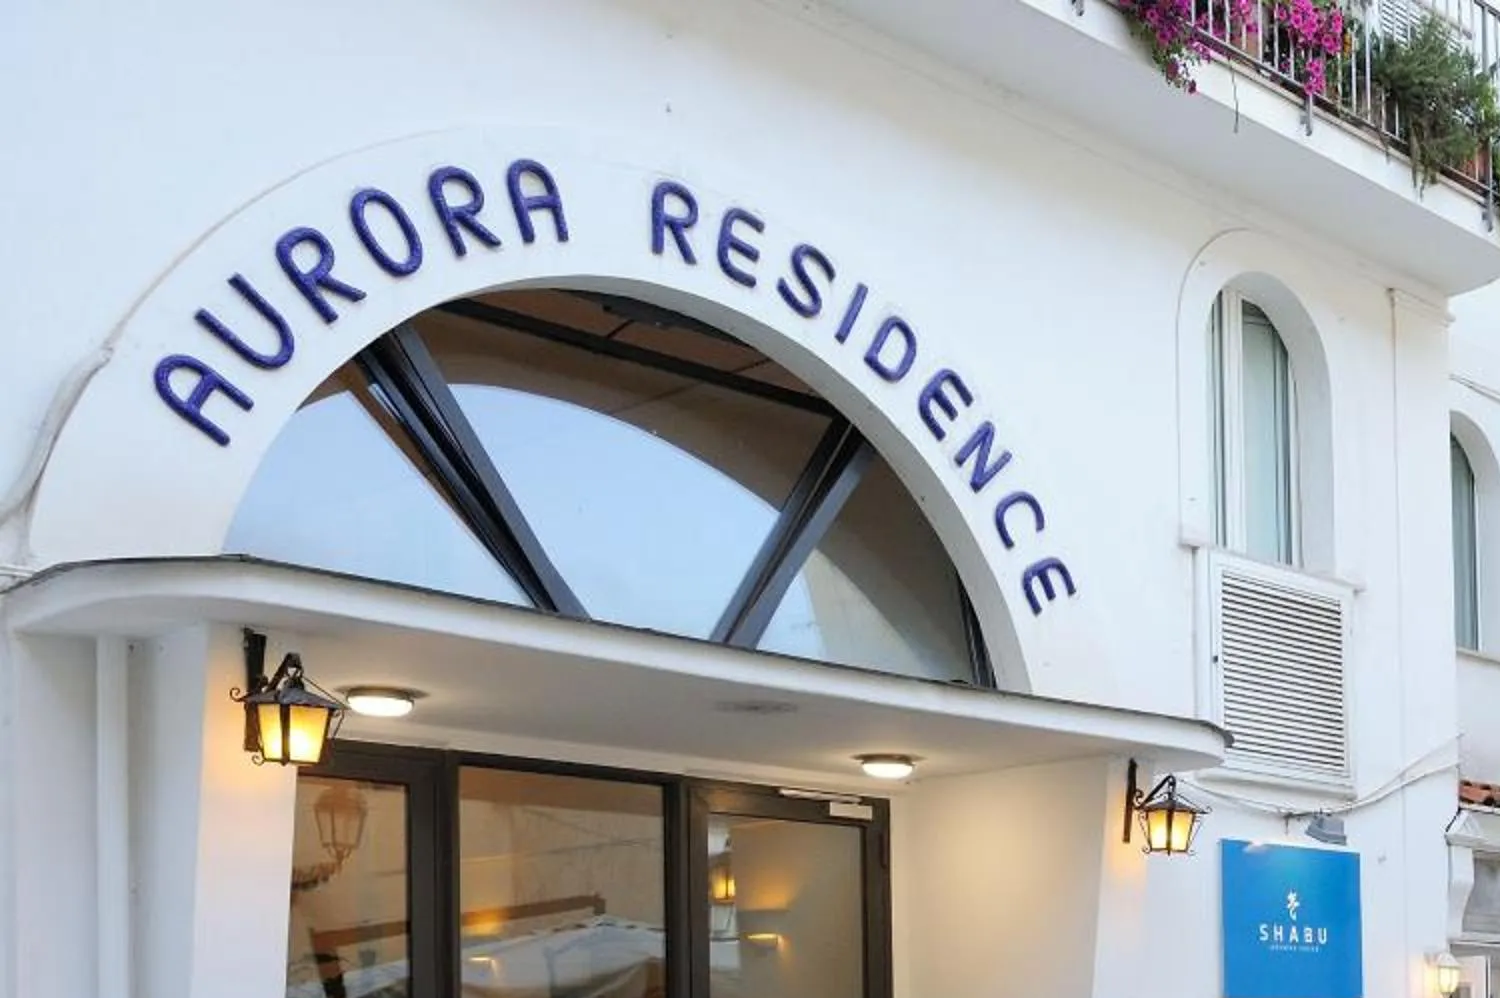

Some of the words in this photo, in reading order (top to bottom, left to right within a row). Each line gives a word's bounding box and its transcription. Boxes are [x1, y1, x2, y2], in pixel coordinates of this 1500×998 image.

[154, 158, 568, 447] AURORA
[652, 180, 1077, 617] RESIDENCE
[1259, 923, 1327, 944] SHABU
